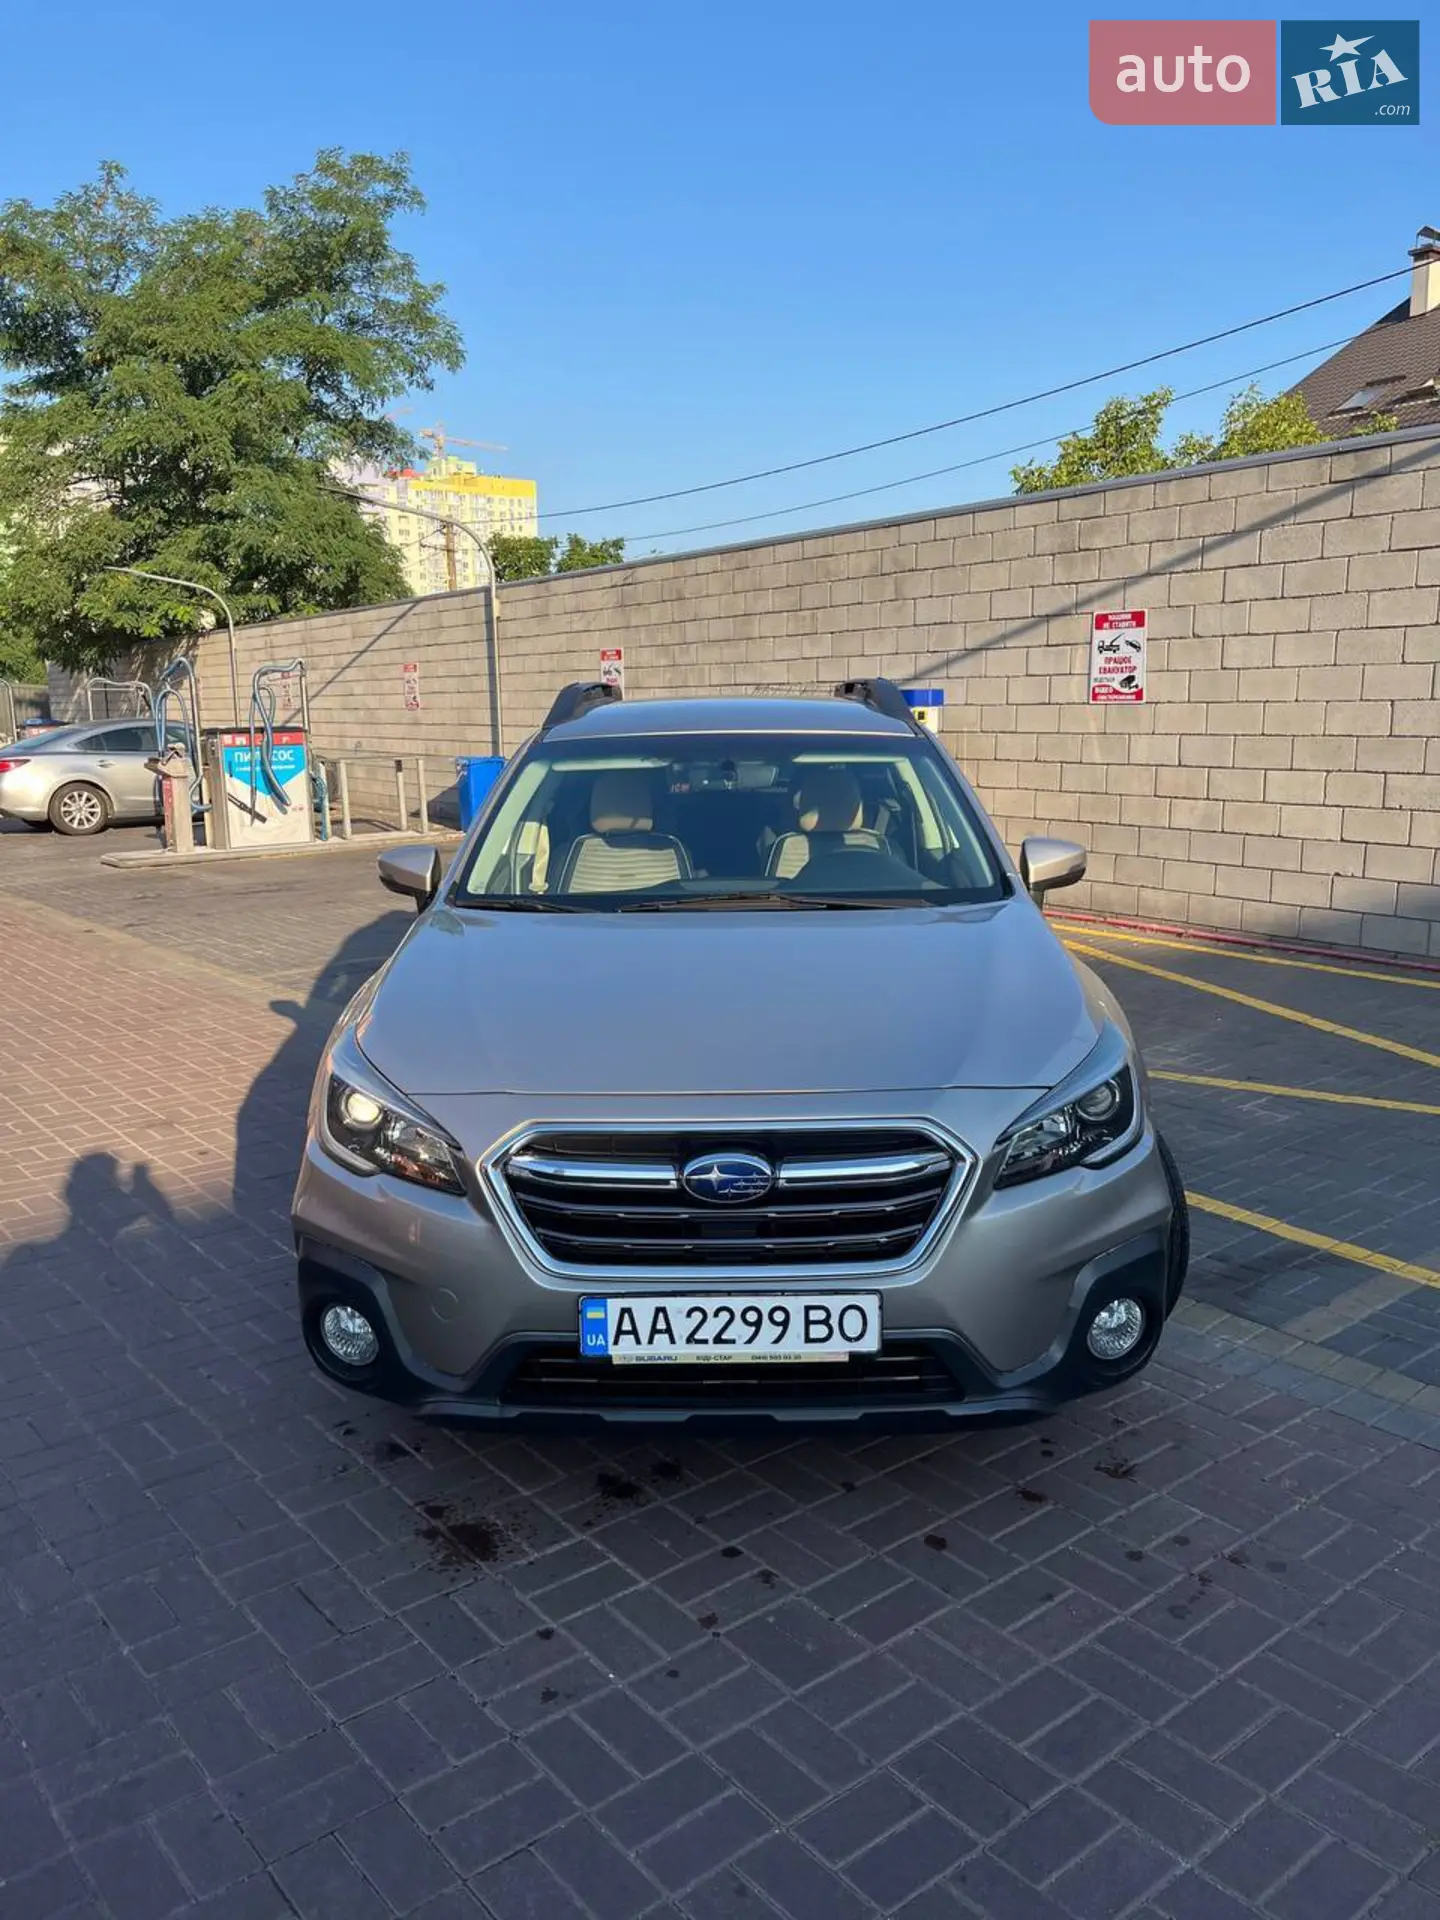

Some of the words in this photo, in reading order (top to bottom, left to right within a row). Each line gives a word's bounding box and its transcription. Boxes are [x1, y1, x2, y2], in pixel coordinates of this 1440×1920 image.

[612, 1307, 677, 1346] AA
[685, 1305, 791, 1345] 2299
[803, 1304, 868, 1344] BO
[587, 1333, 606, 1347] UA
